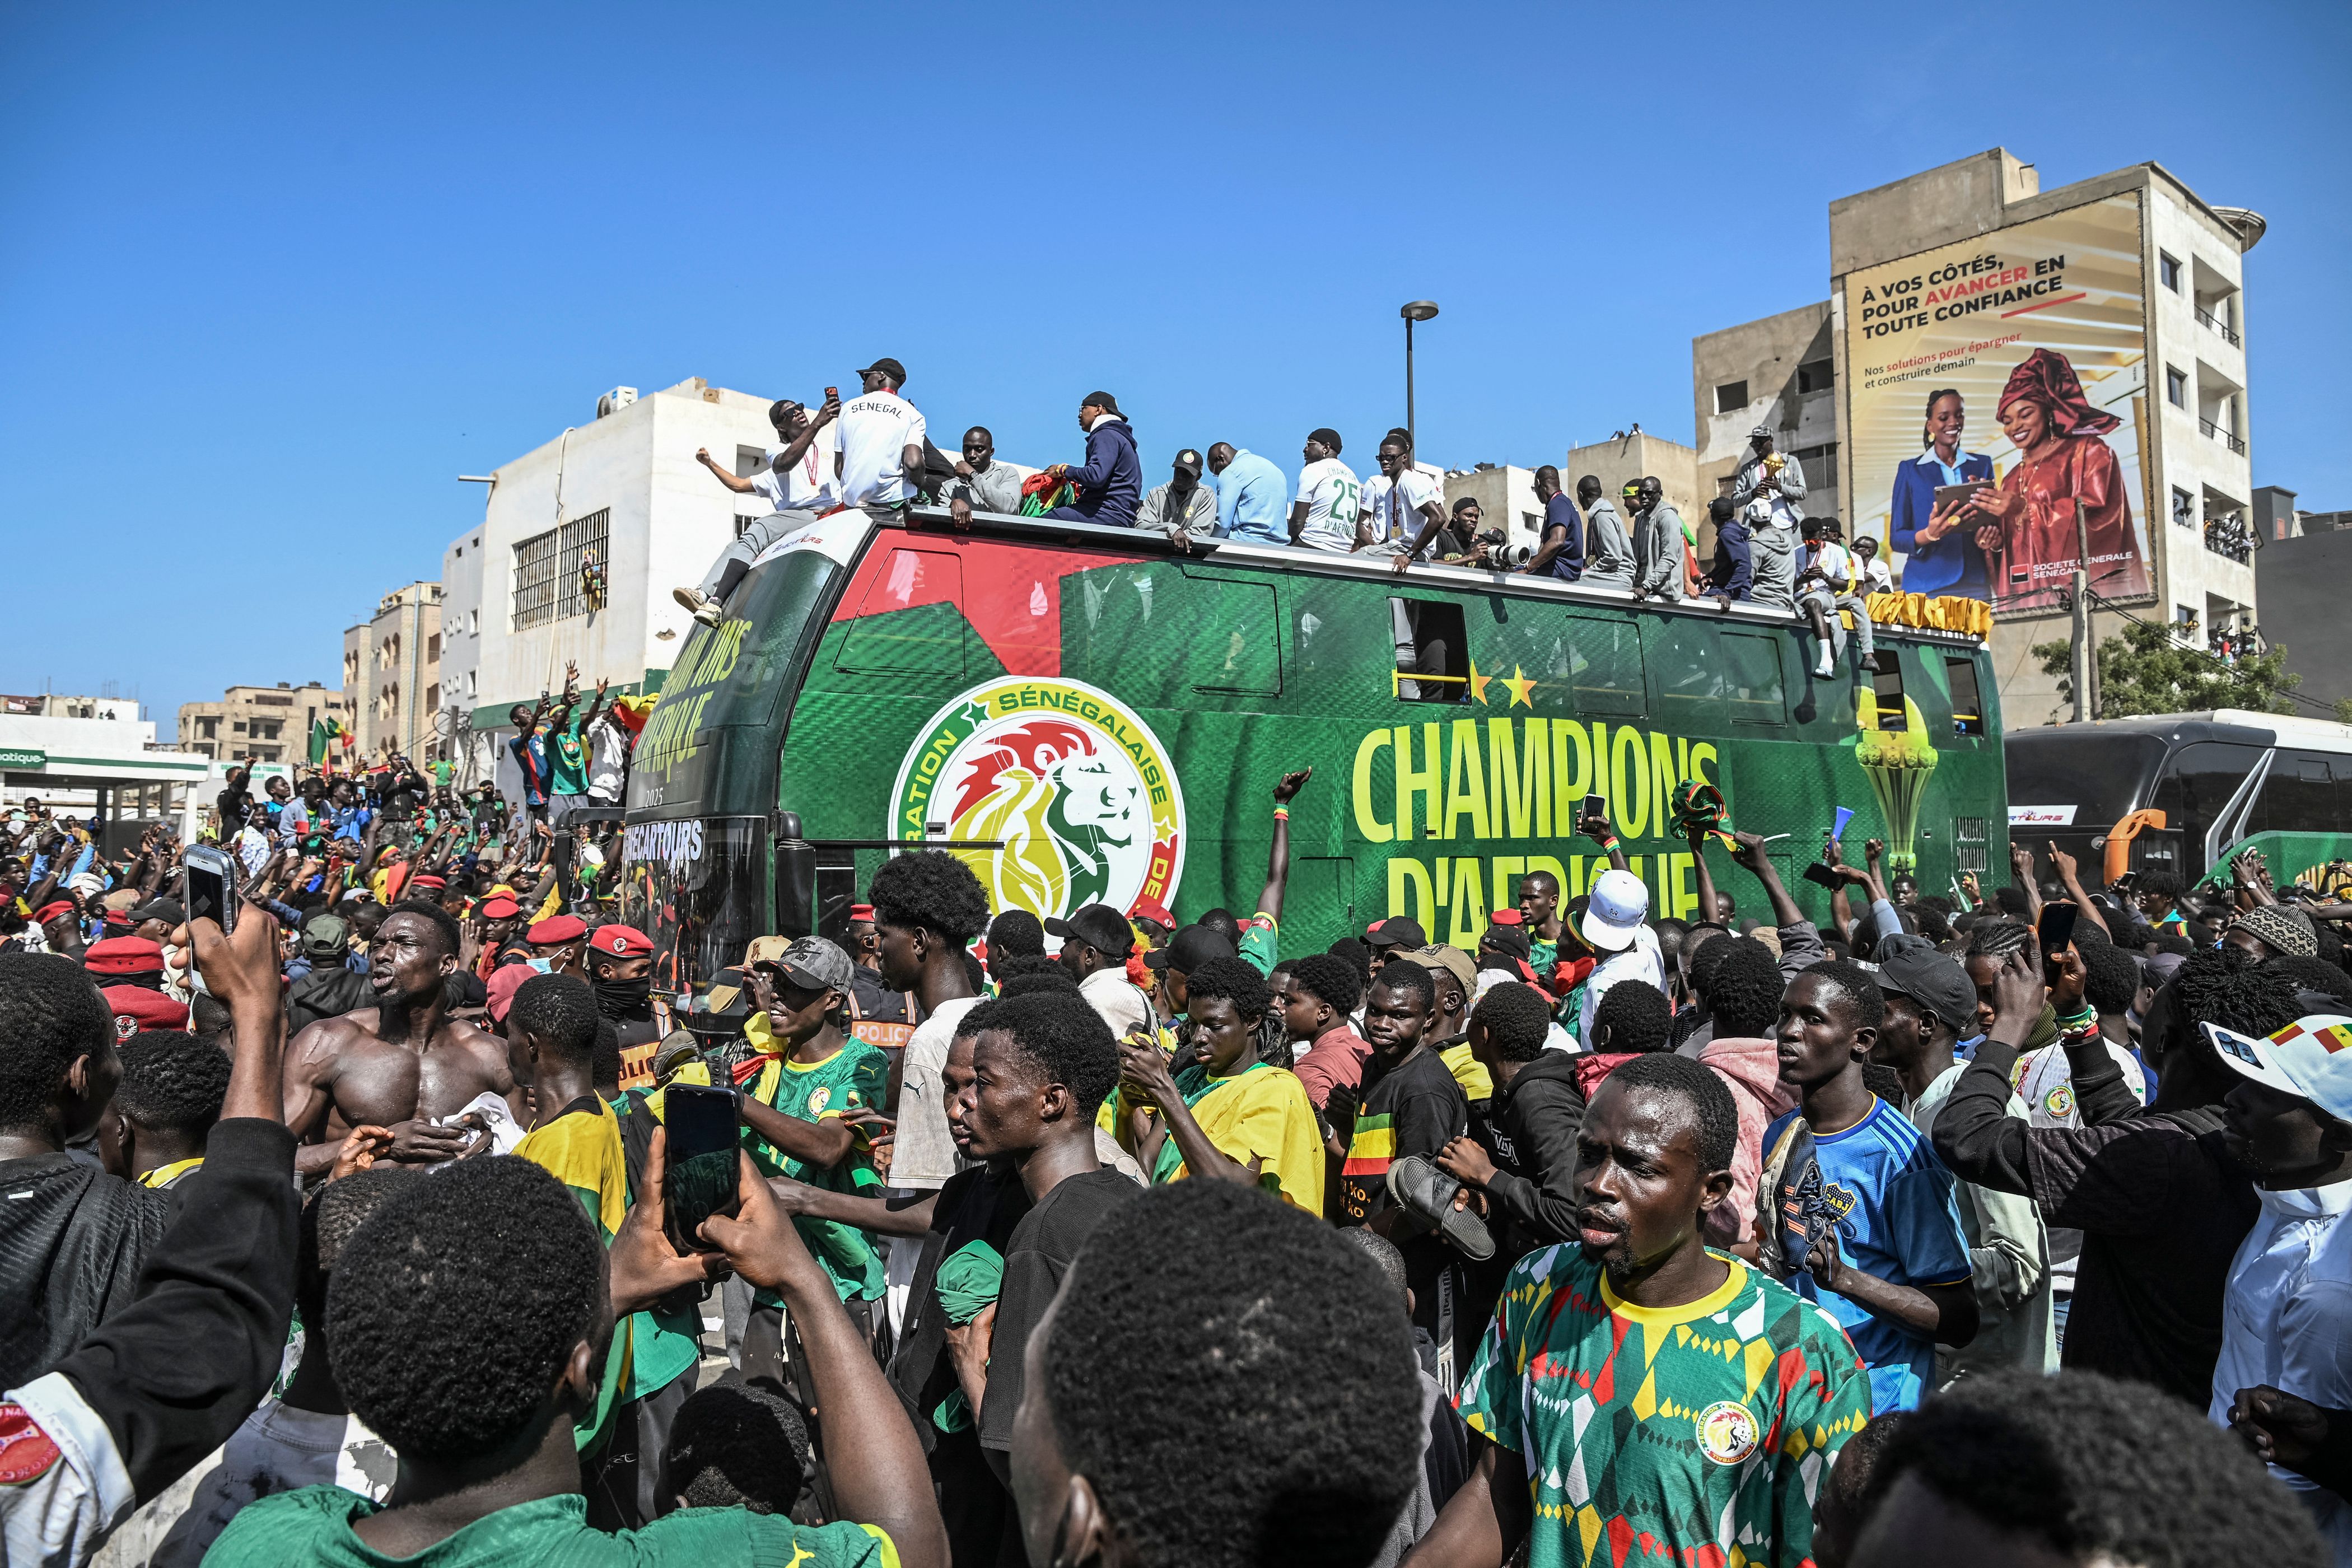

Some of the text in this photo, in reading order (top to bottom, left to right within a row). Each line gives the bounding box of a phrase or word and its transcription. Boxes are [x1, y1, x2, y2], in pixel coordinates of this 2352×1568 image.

[1861, 254, 2004, 305] À VOS CÔTÉS,
[1863, 255, 2065, 322] POUR AVANCER EN
[1863, 275, 2062, 340] TOUTE CONFIANCE
[1864, 332, 2022, 377] Nos solutions pour épargner
[1865, 356, 1975, 389] et construire demain
[851, 402, 902, 419] SENEGAL
[1329, 478, 1358, 524] 25
[2033, 551, 2133, 572] SOCIETE ENERALE
[2033, 567, 2078, 579] SENEGAL
[645, 787, 664, 808] 2025
[905, 685, 1169, 900] RATION SÉNÉGALAISE DE
[624, 819, 702, 861] ENECARTOURS
[1388, 852, 1699, 956] D'AFRUE
[857, 1025, 913, 1042] POLICE
[619, 1056, 655, 1081] OLIC
